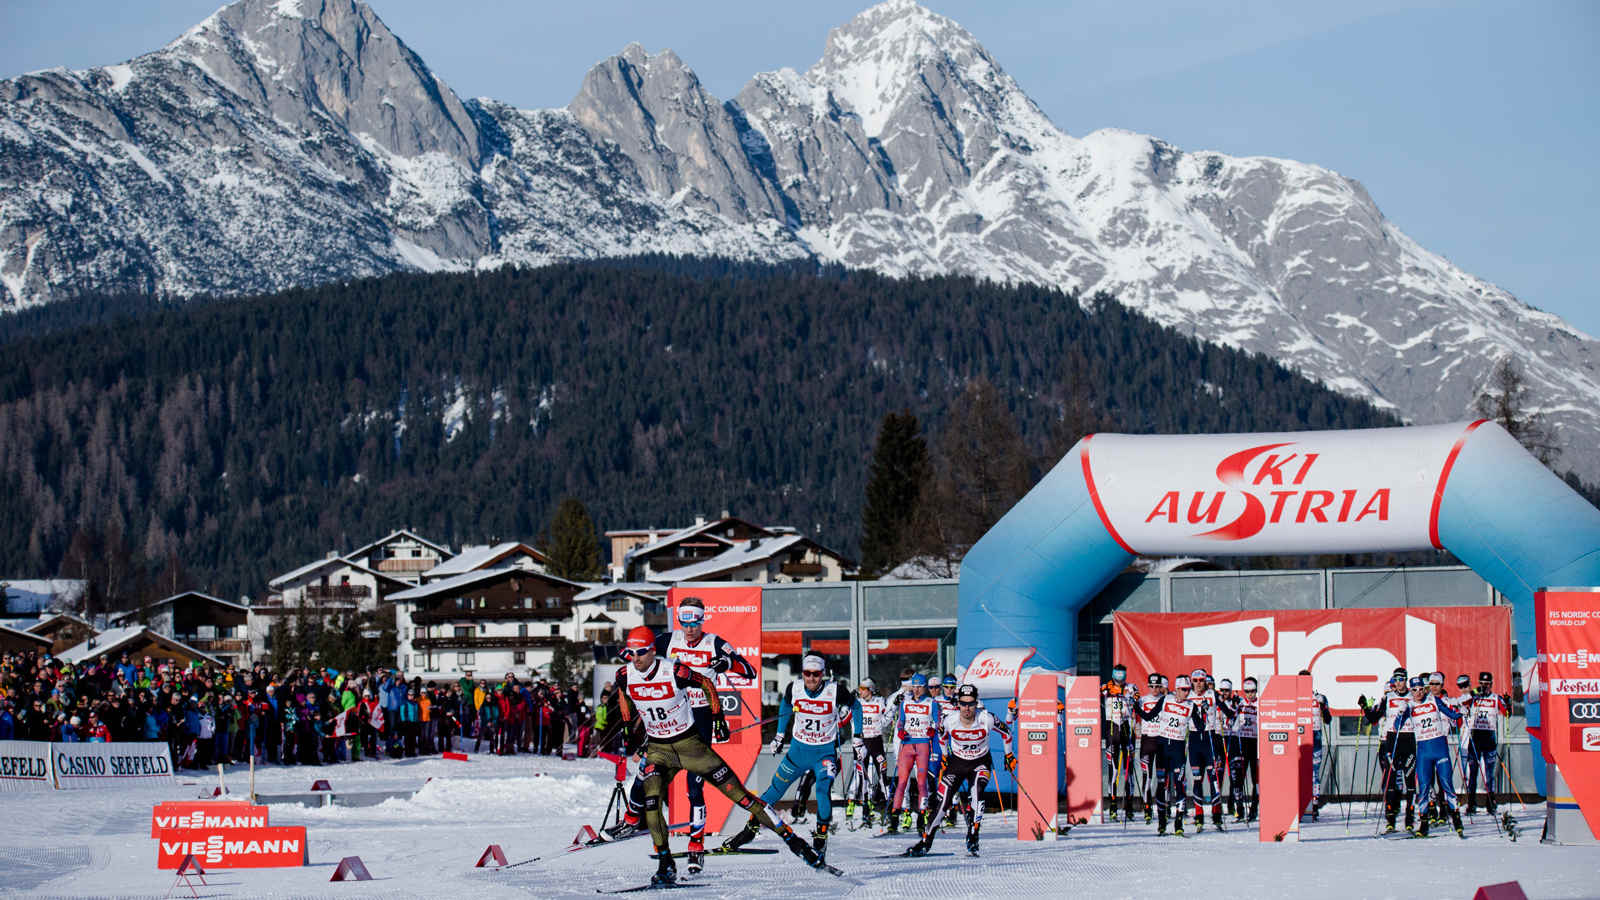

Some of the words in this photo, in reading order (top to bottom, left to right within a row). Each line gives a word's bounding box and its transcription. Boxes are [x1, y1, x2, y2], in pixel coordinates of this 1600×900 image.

[1145, 488, 1391, 541] AUSTRIA
[717, 605, 758, 614] COMBINED
[1183, 614, 1437, 710] Tirol
[634, 684, 671, 698] Tirol
[1556, 679, 1599, 694] Seefeld
[798, 701, 829, 713] Tirol
[646, 708, 667, 722] 18
[1479, 710, 1488, 719] 37
[805, 718, 821, 732] 21
[910, 718, 920, 727] 24
[1169, 717, 1180, 728] 23
[1421, 718, 1433, 728] 22
[0, 757, 47, 777] EFELD
[58, 752, 106, 776] CASINO
[110, 755, 169, 776] SEEFELD
[162, 835, 300, 863] VIESSMANN
